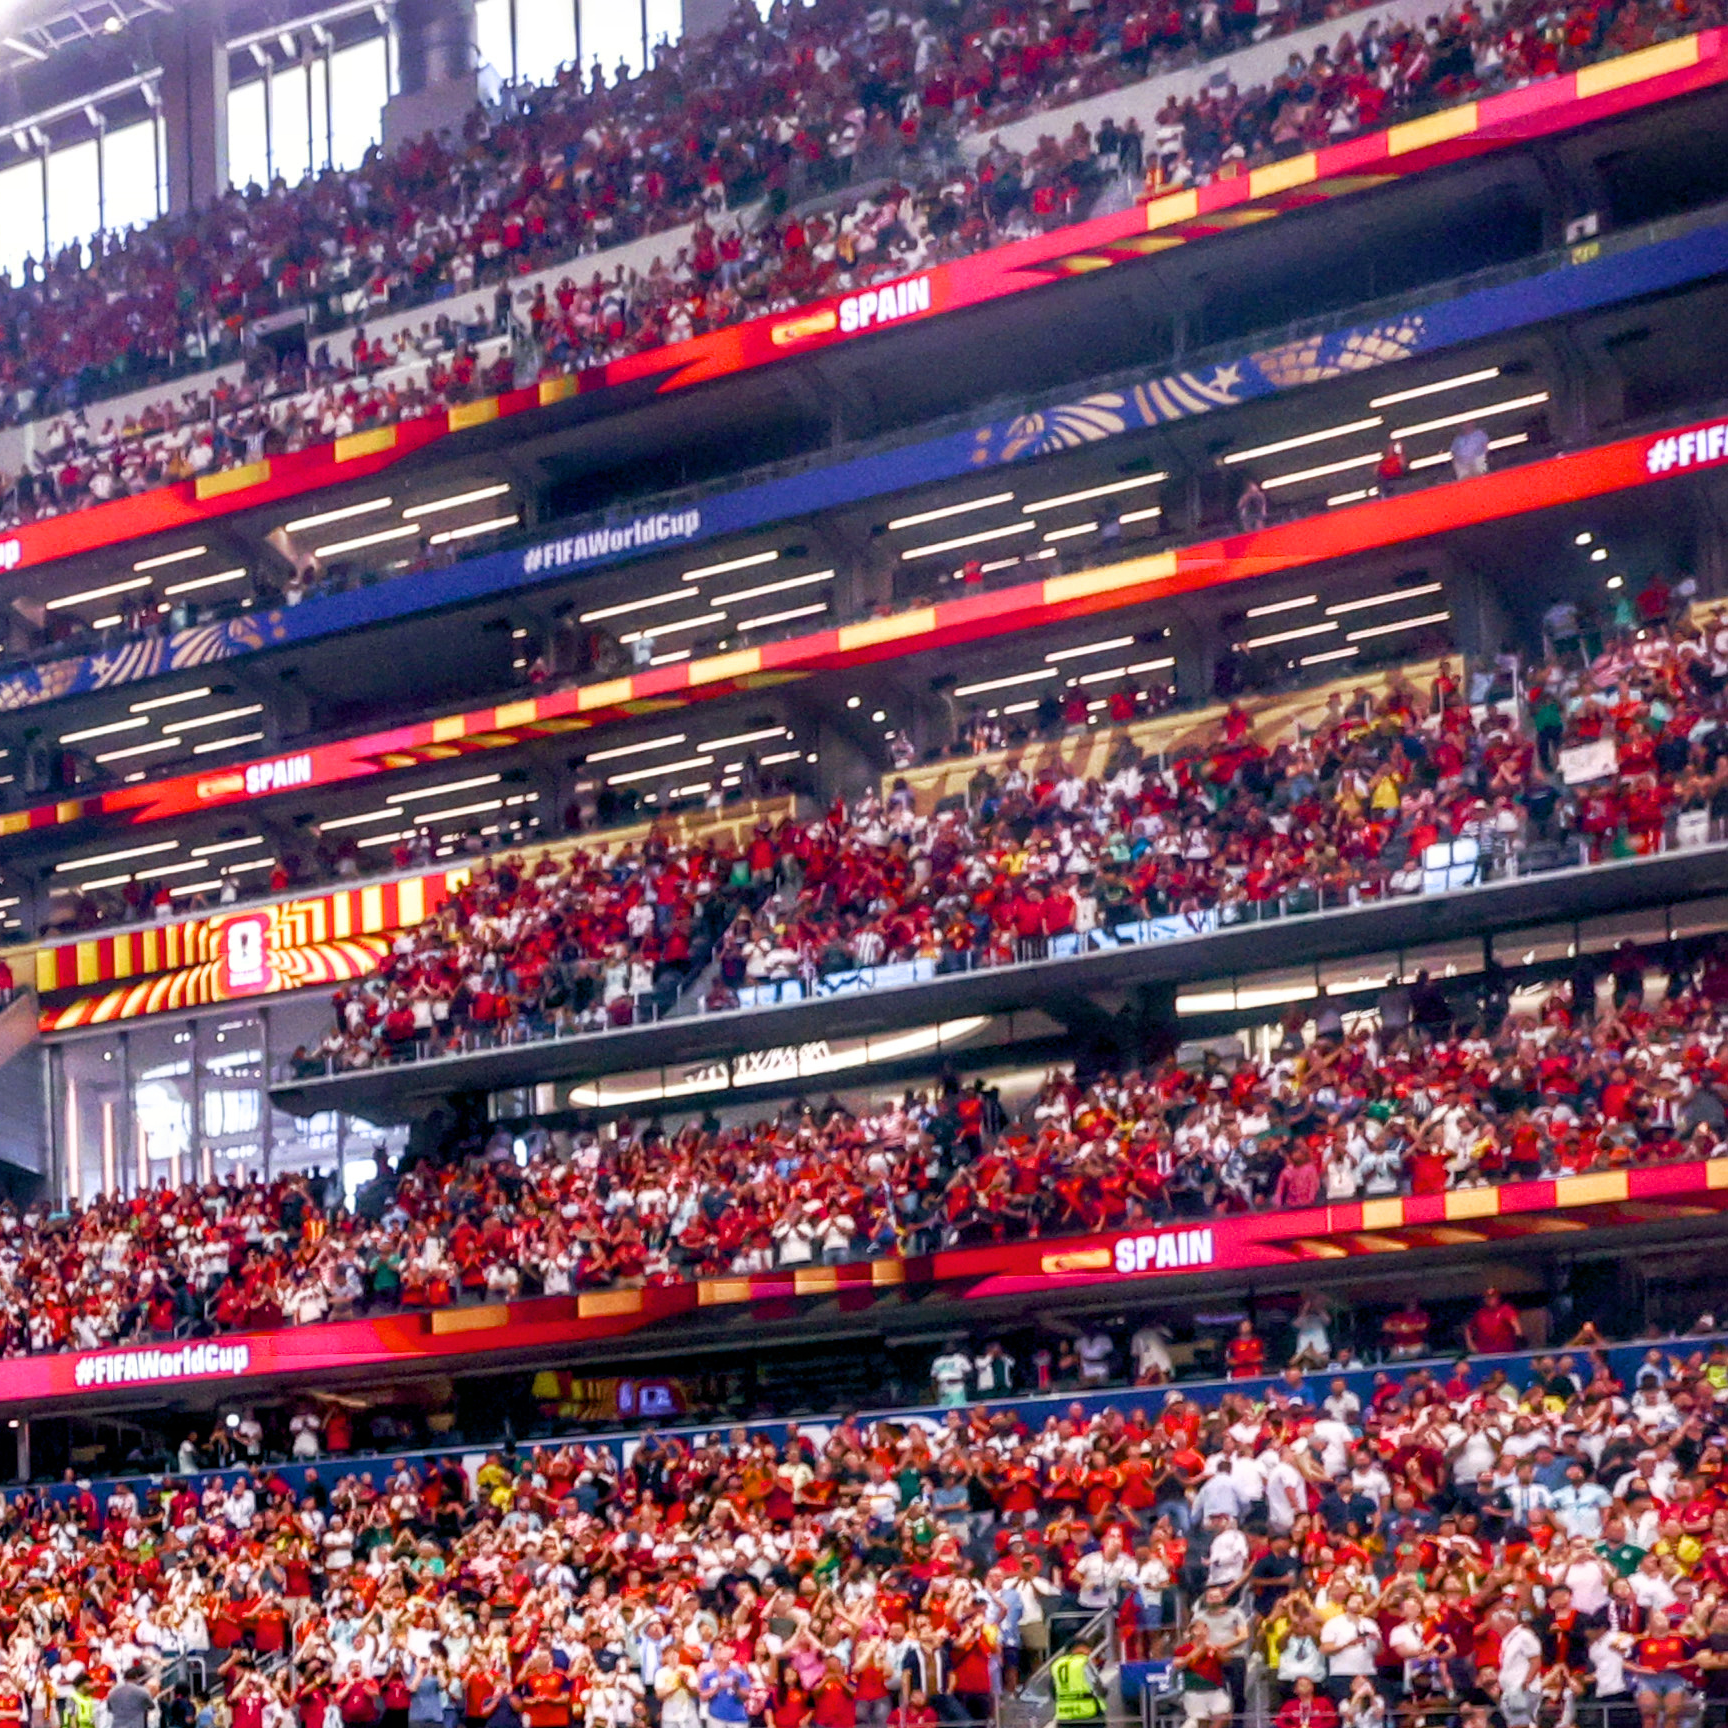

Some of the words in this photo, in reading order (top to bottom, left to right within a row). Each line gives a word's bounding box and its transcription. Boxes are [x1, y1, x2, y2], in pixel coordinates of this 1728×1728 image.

[839, 276, 930, 333] SPAIN
[1646, 424, 1728, 474] #FIF
[523, 508, 701, 574] #FIFAWorldCup
[246, 754, 312, 794] SPAIN
[1115, 1228, 1213, 1273] SPAIN
[75, 1344, 249, 1386] #FIFAWorldCup
